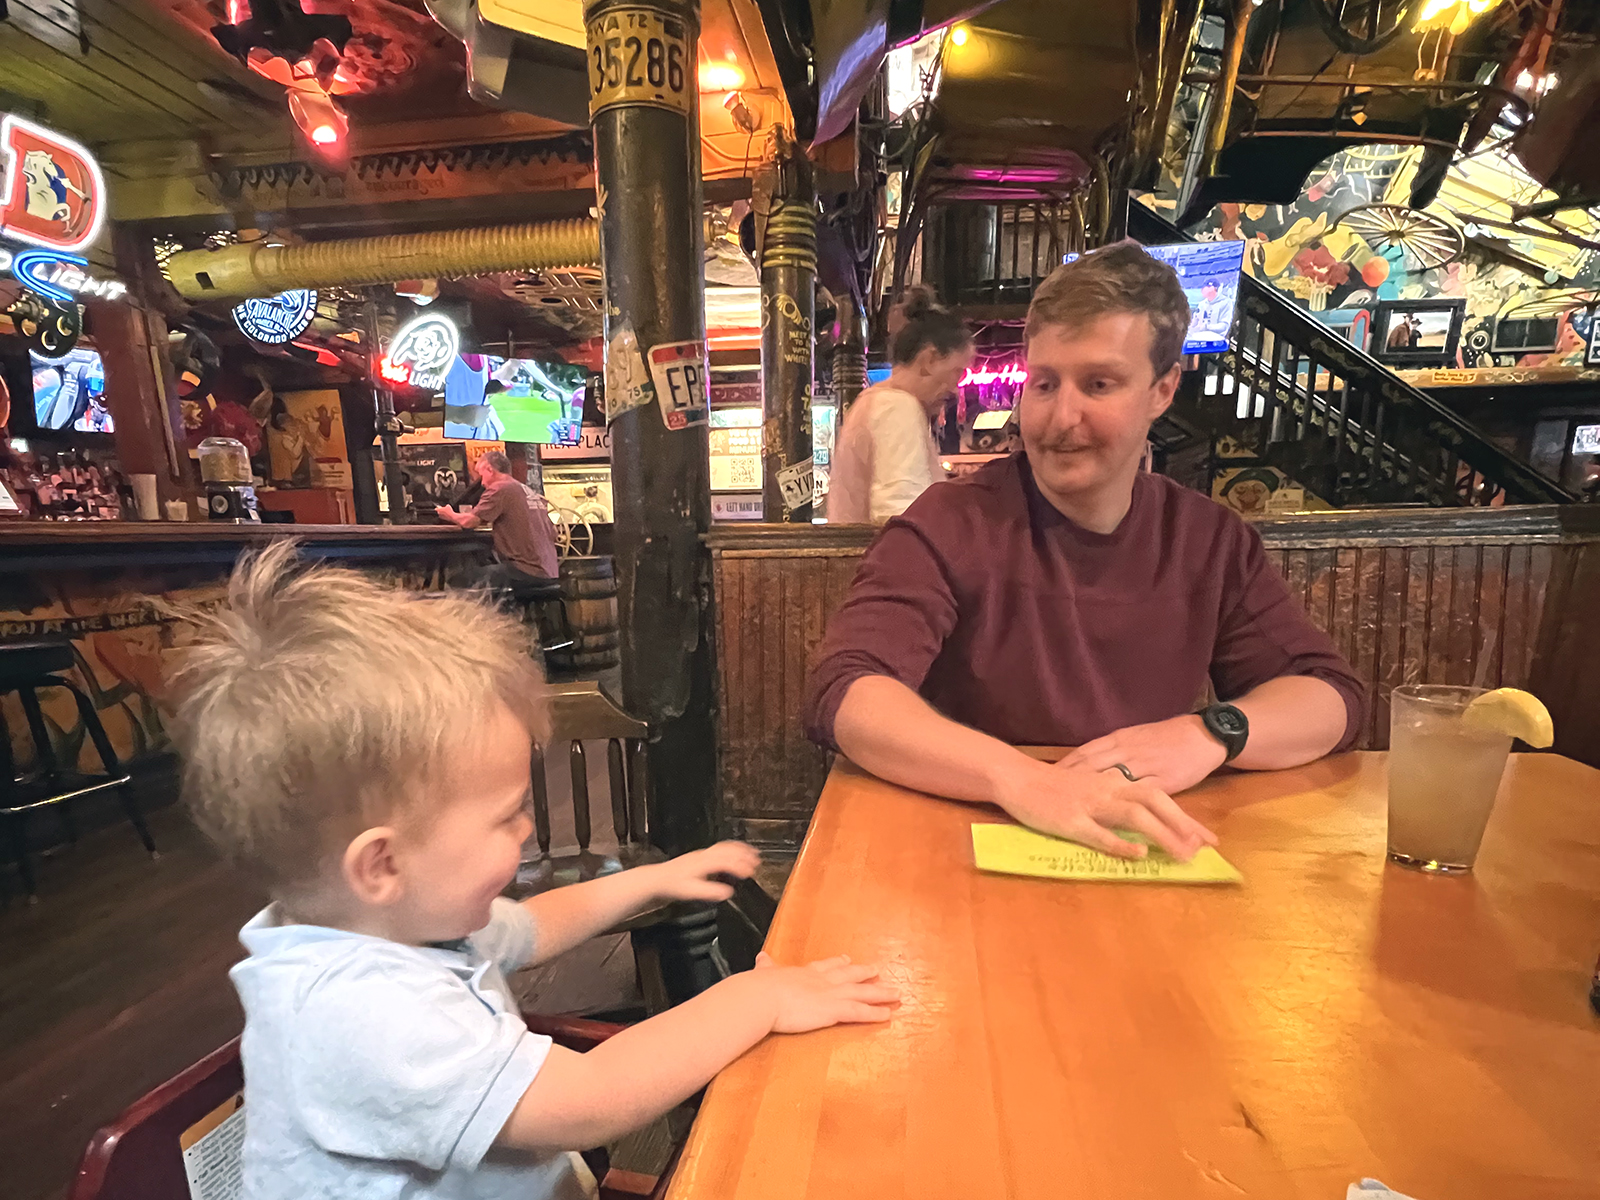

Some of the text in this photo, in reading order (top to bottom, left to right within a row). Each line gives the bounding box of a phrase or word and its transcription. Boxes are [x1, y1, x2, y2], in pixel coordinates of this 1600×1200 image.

[593, 36, 684, 93] 35286
[32, 262, 127, 300] LIGHT
[243, 321, 287, 343] COLORADO
[289, 318, 309, 340] ALES
[250, 301, 296, 332] AVALANCHE
[409, 371, 443, 391] LIGHT
